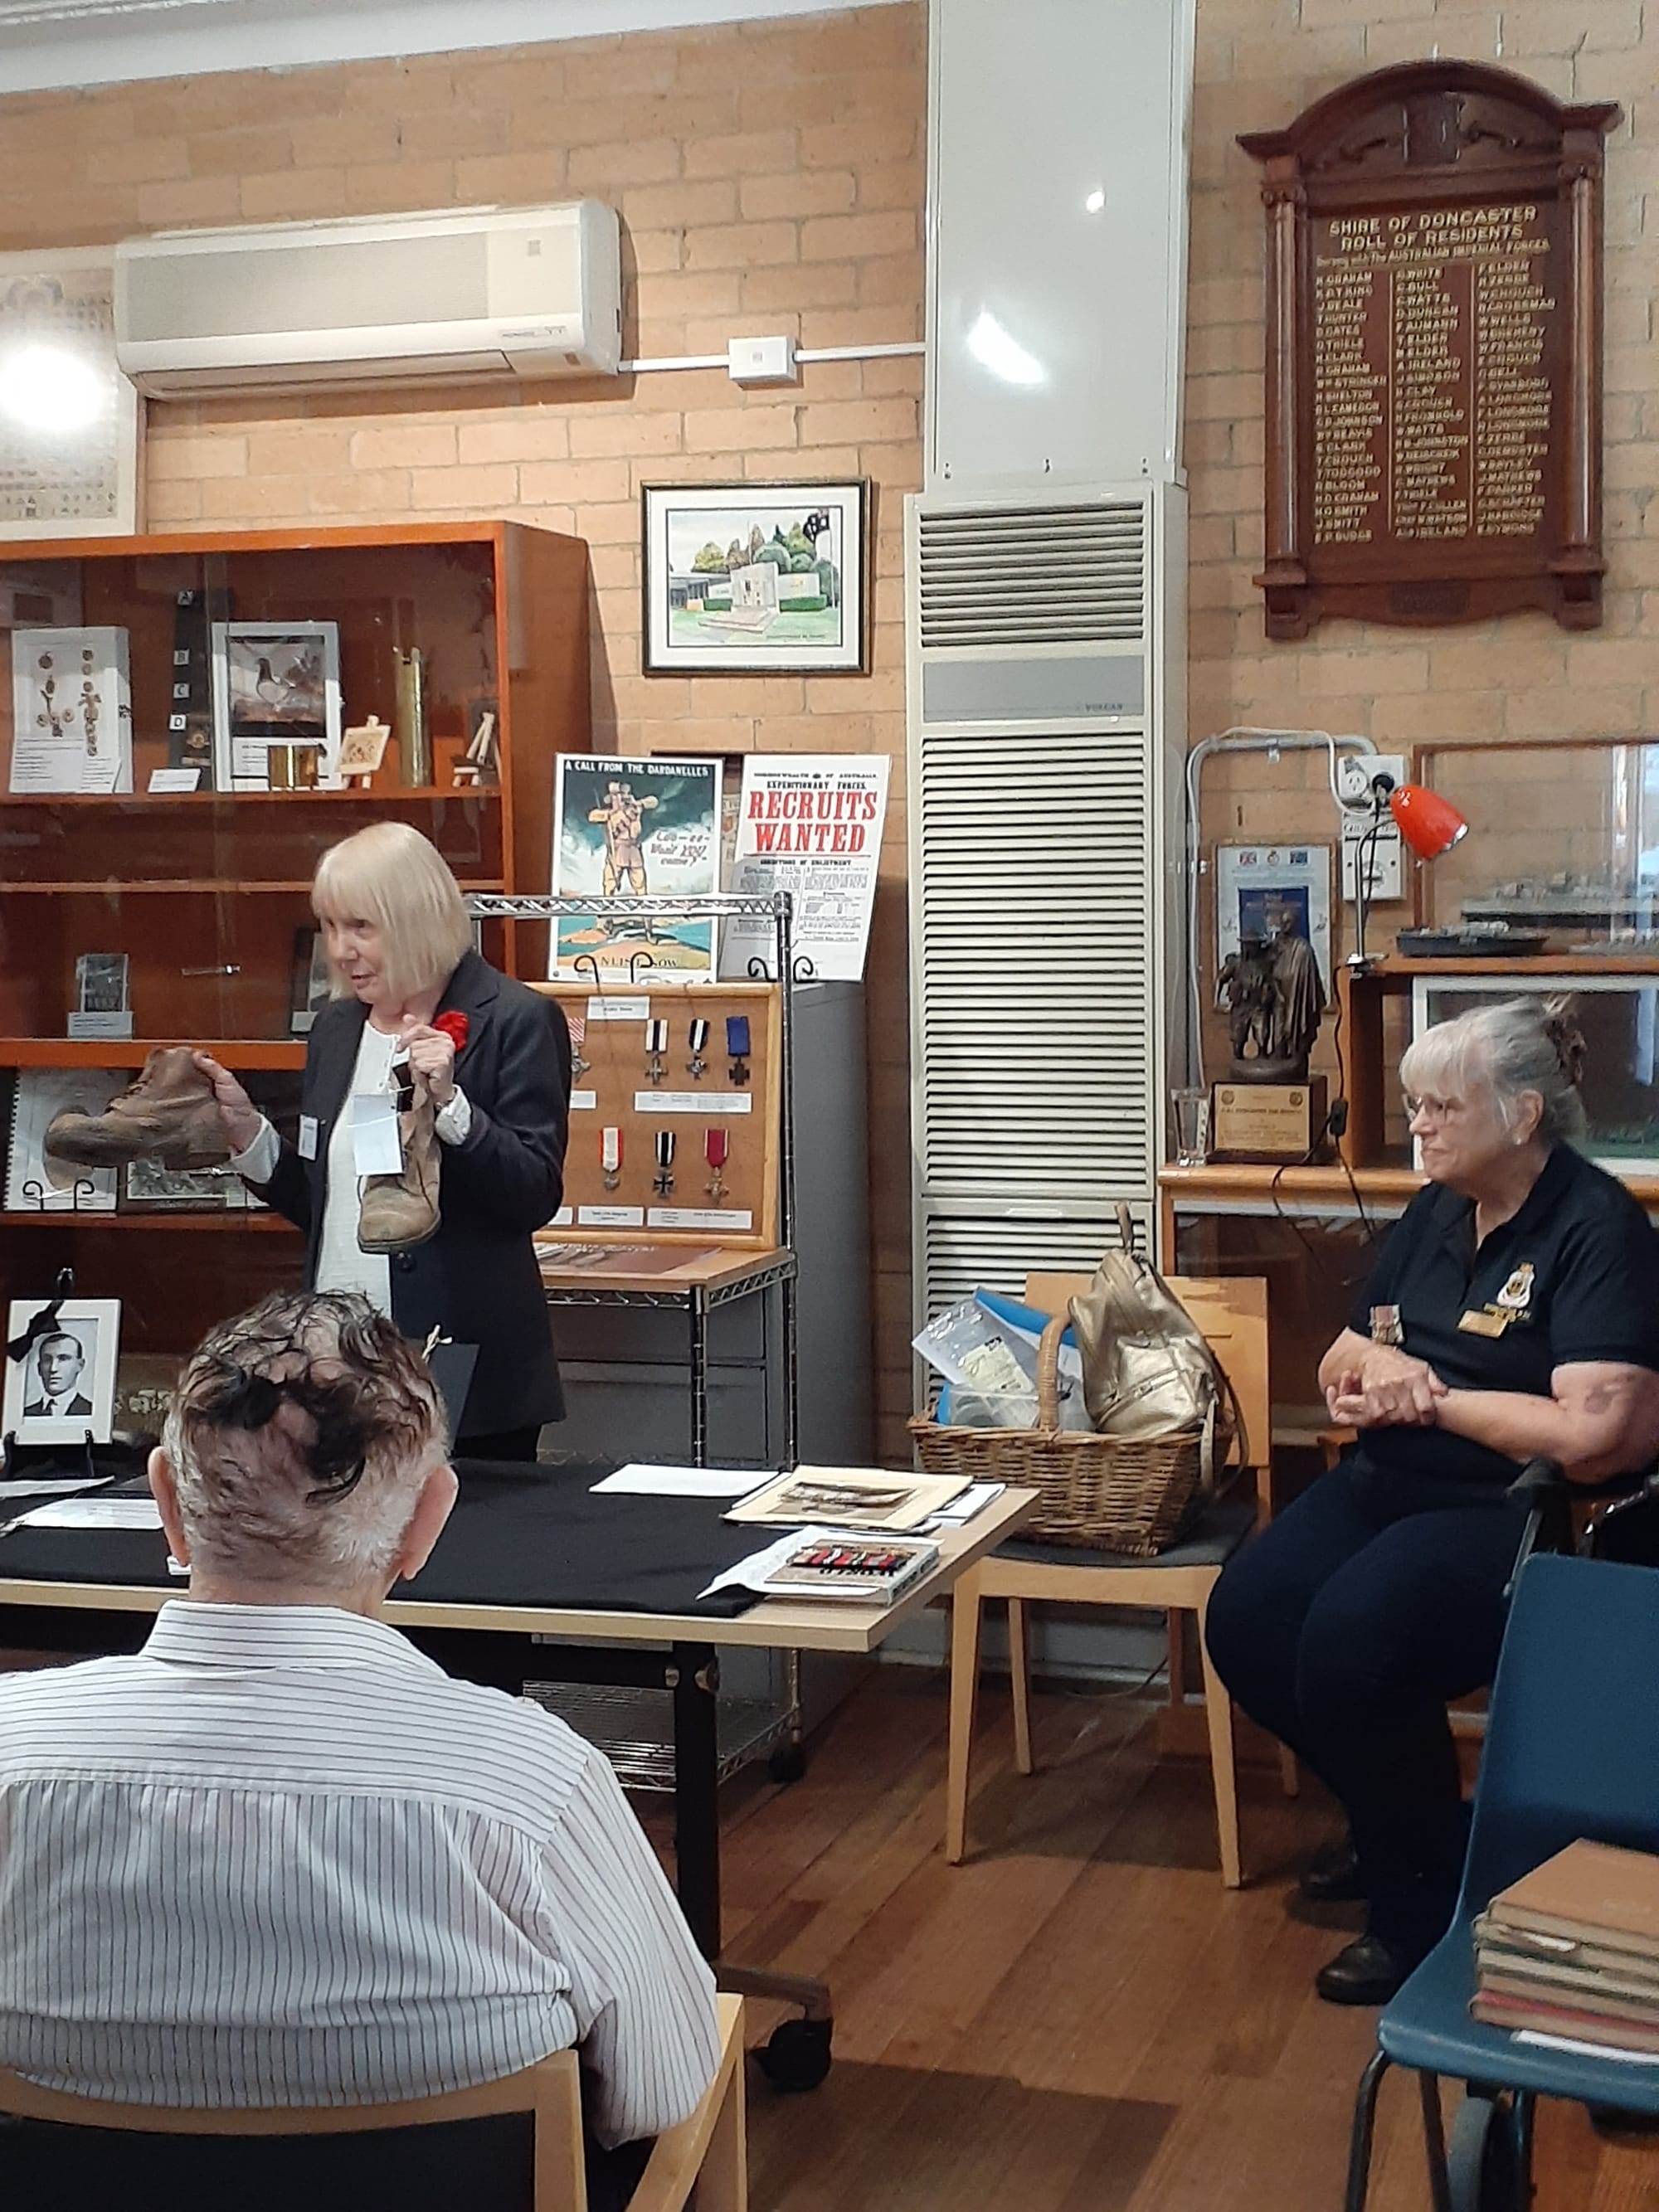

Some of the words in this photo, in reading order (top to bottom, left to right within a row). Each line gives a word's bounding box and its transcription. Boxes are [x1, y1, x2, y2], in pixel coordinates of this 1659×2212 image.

[1329, 217, 1381, 237] SHIRE
[1388, 216, 1411, 232] OF
[1418, 205, 1536, 231] DONCASTER
[1340, 236, 1386, 252] ROLL
[1394, 231, 1418, 247] OF
[1425, 224, 1524, 245] RESIDENTS
[1388, 246, 1450, 262] AUSTRALIAN
[177, 651, 186, 663] B
[178, 683, 186, 695] C
[173, 717, 183, 727] D
[565, 760, 572, 771] A
[575, 761, 596, 772] CALL
[597, 761, 623, 774] FROM
[628, 763, 645, 775] THE
[648, 765, 708, 777] DARDANELLES
[767, 780, 830, 790] EXPEDITIONARY
[747, 790, 878, 821] RECRUITS
[755, 823, 866, 853] WANTED
